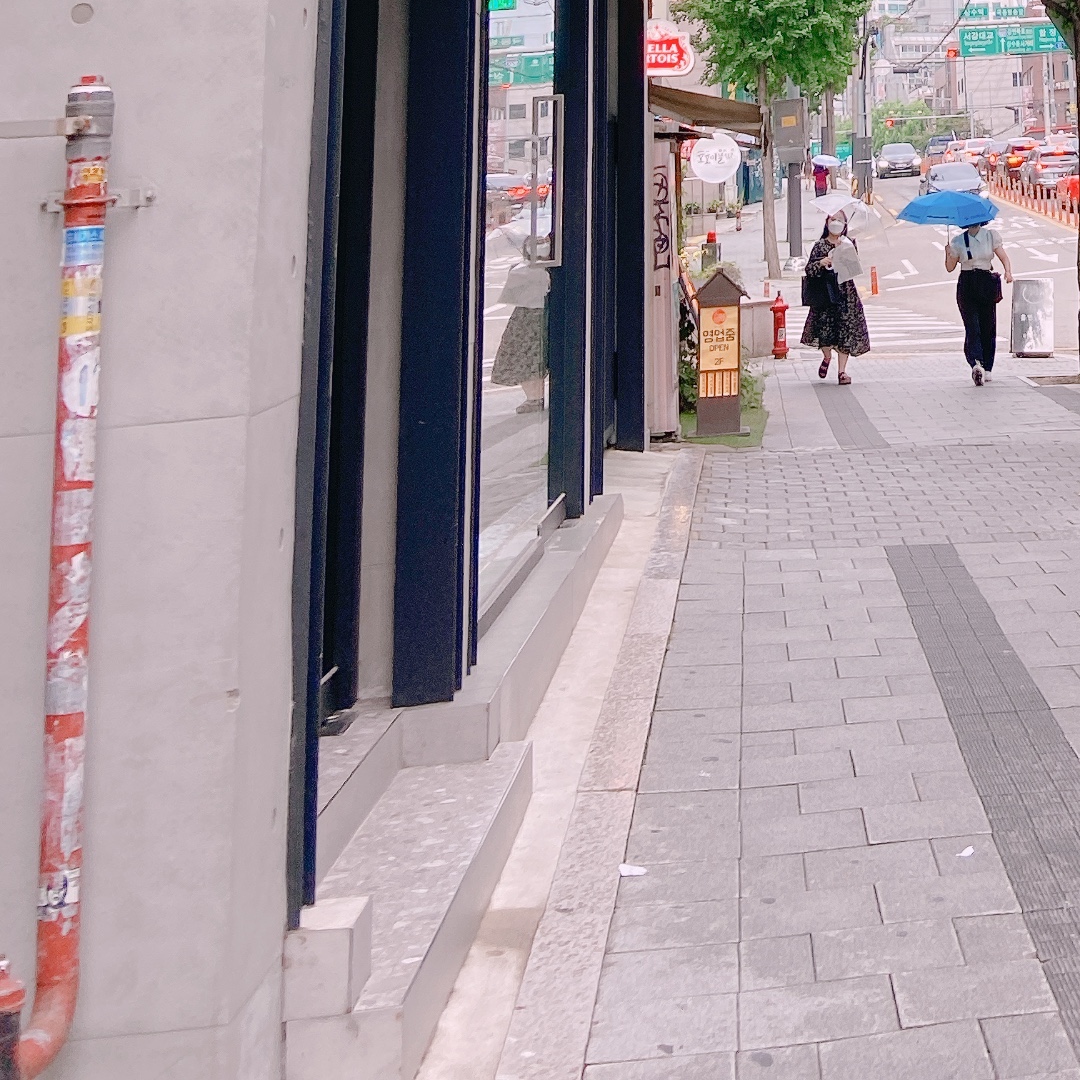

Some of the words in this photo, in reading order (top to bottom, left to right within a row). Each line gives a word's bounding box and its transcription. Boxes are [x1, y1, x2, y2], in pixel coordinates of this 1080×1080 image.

[963, 31, 994, 41] 서강대교
[647, 43, 679, 53] ELLA
[702, 328, 736, 343] 영업중
[708, 343, 729, 352] OPEN
[714, 357, 724, 366] 2F
